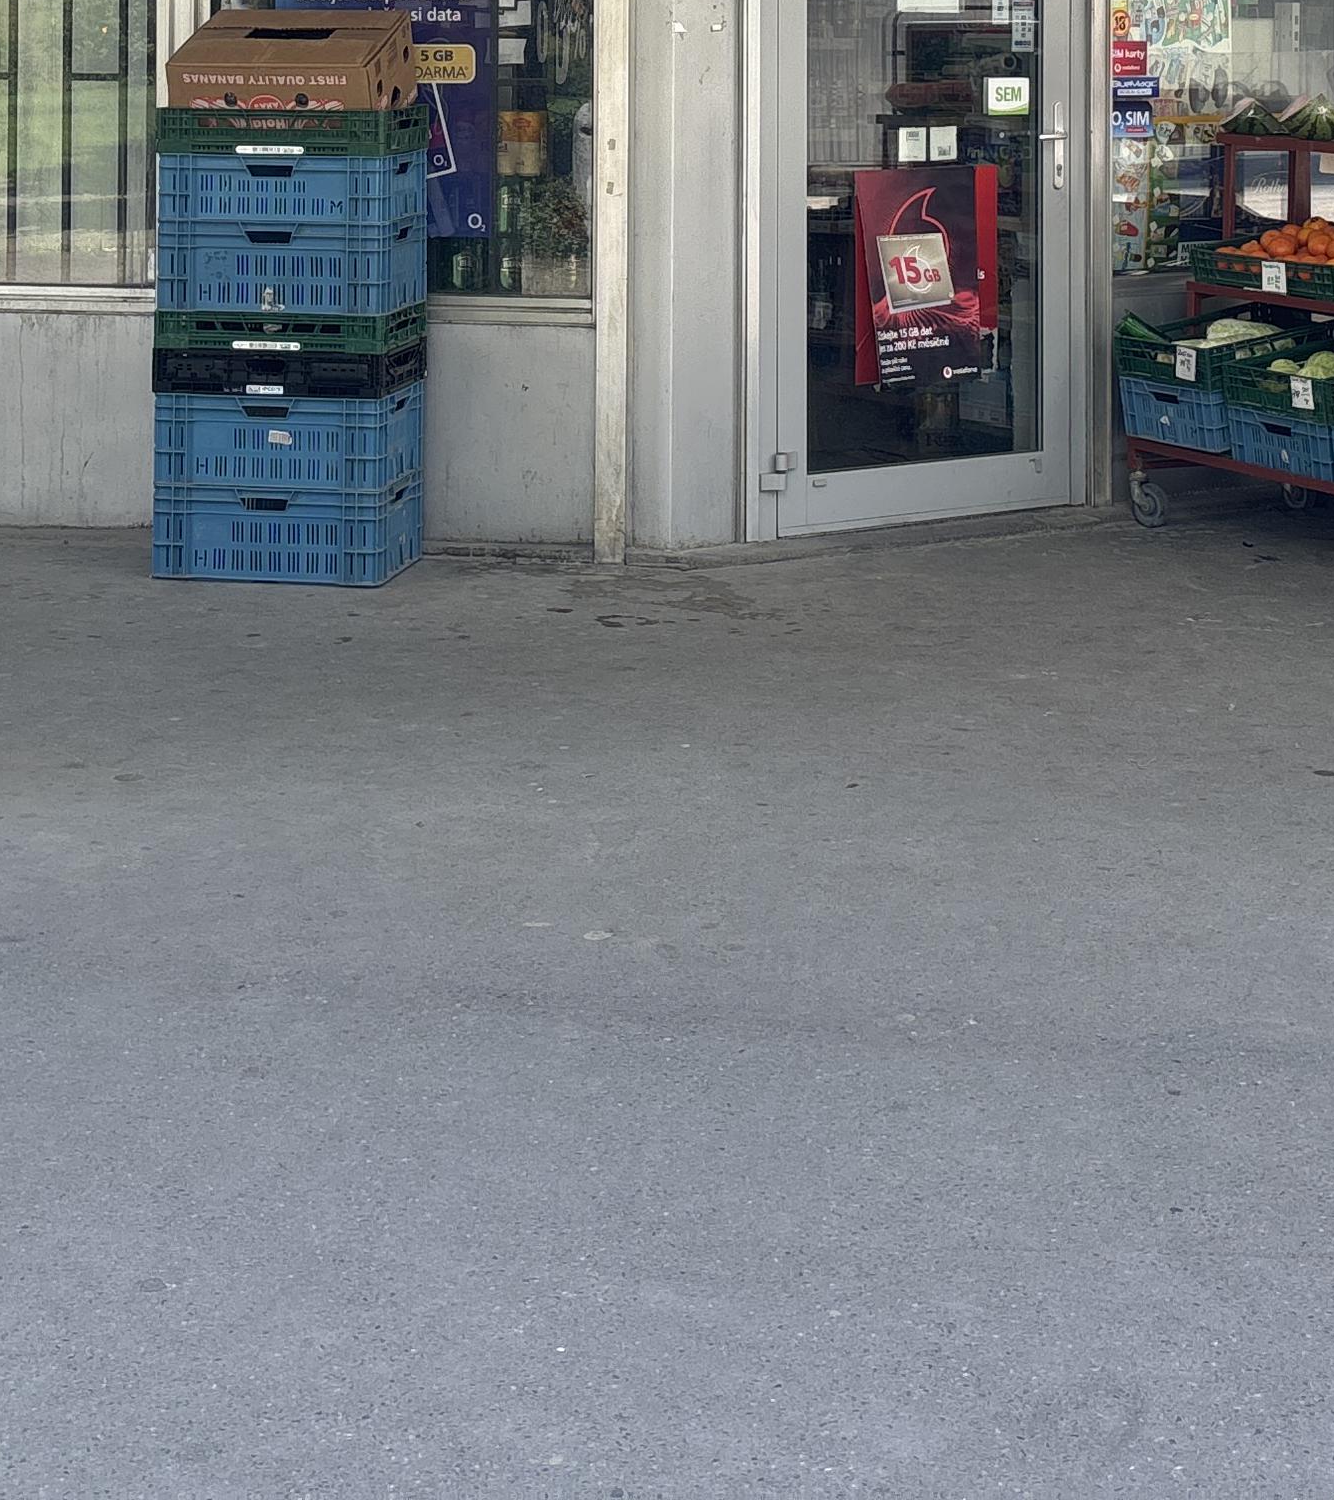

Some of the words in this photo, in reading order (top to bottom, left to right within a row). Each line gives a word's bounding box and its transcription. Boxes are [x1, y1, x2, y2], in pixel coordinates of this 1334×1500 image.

[426, 7, 462, 22] data
[420, 50, 429, 62] 5
[433, 50, 454, 62] GB
[415, 66, 467, 79] DARMA
[182, 73, 245, 85] BANANAS
[248, 74, 305, 86] QUALITY
[309, 74, 347, 86] FIRST
[995, 86, 1022, 102] SEM
[1126, 111, 1150, 126] SIM
[889, 257, 922, 285] 15
[924, 268, 942, 283] GB
[899, 328, 907, 338] 15
[908, 327, 919, 337] GB
[893, 341, 906, 351] 200
